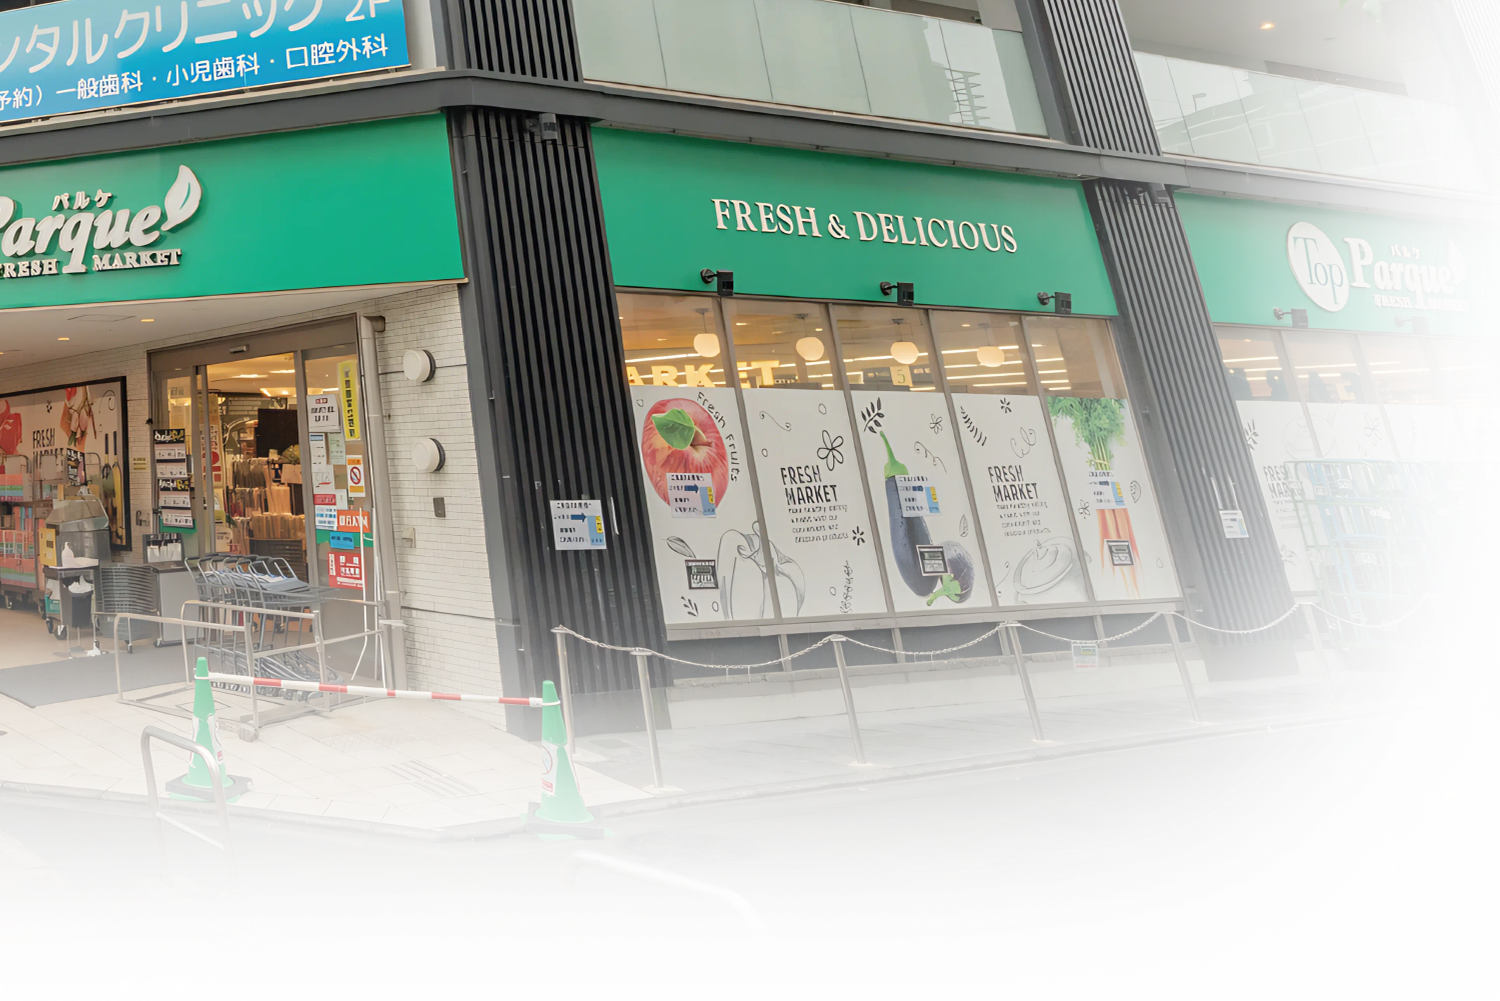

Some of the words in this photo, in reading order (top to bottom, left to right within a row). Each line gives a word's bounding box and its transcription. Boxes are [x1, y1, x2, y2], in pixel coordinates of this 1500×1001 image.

[711, 198, 822, 238] FRESH
[827, 213, 850, 240] &
[853, 211, 1018, 253] DELICIOUS
[92, 248, 182, 271] MARKET
[1292, 236, 1344, 305] Top
[1342, 237, 1455, 310] Parque
[32, 428, 55, 449] FRESH
[780, 465, 822, 485] FRESH
[988, 465, 1024, 484] FRESH
[785, 485, 838, 505] MARKET
[992, 483, 1038, 502] MARKET
